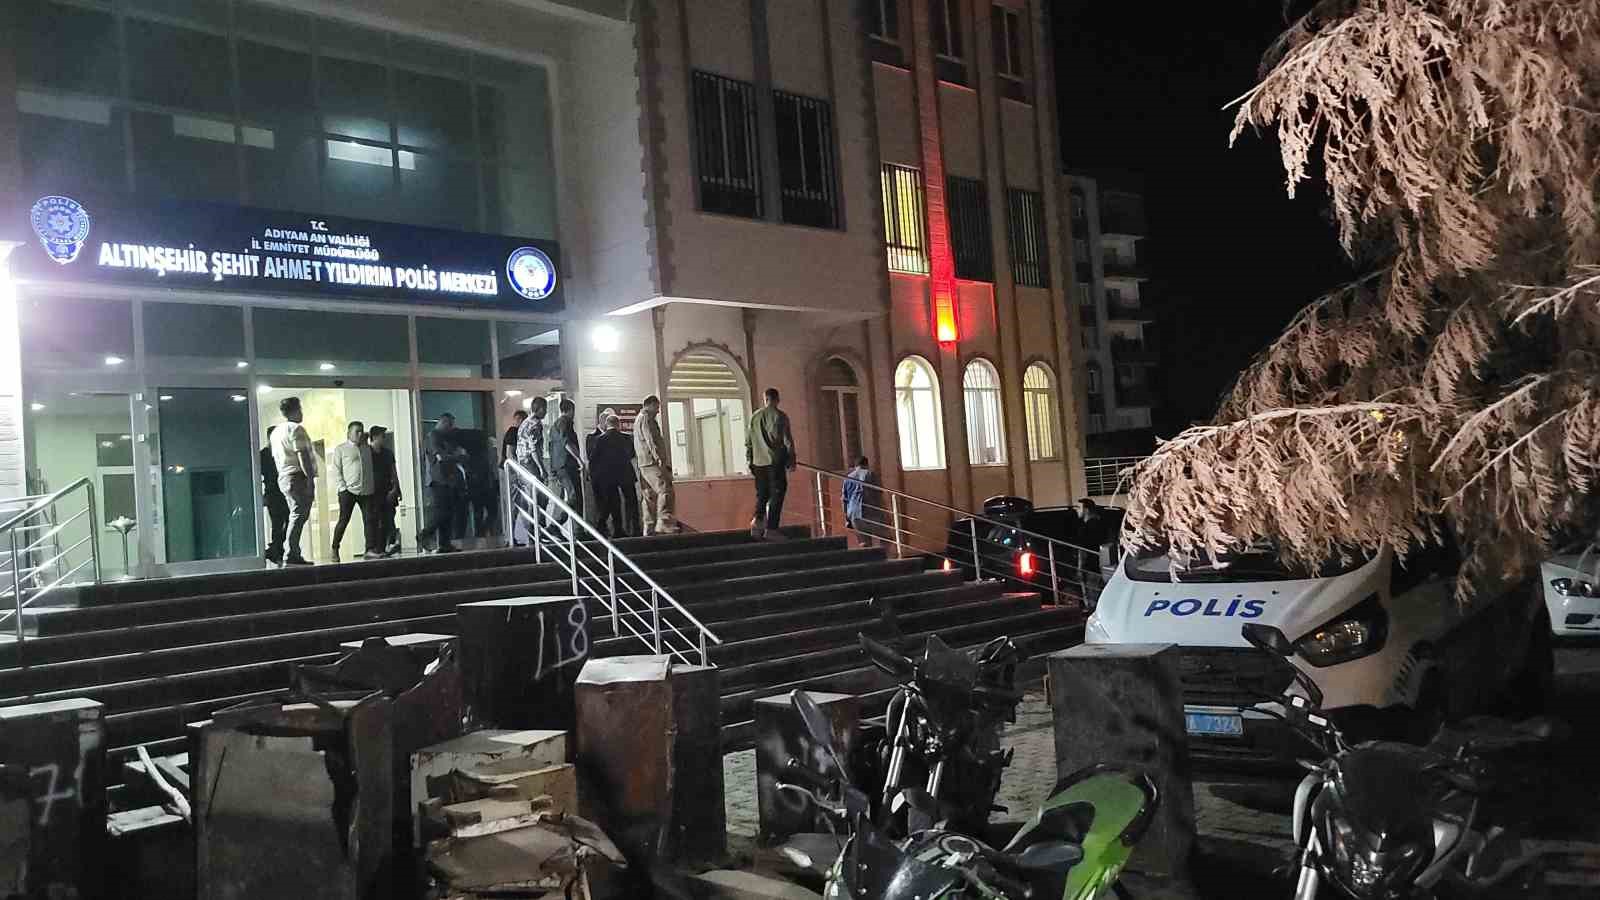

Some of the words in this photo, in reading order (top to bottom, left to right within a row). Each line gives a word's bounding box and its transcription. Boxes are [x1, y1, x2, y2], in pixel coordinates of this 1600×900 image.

[310, 220, 328, 231] T.C.
[251, 237, 261, 249] İL
[263, 240, 310, 254] EMNİYET
[313, 245, 380, 261] MÜDÜRLÜĞÜ
[98, 242, 209, 277] ALTINŞEHİR
[211, 249, 260, 281] ŞEHİT
[263, 256, 323, 281] AHMET
[325, 261, 394, 287] YILDIRIM
[396, 264, 437, 291] POLİS
[439, 270, 498, 295] MERKEZİ
[1143, 594, 1267, 619] POLİS
